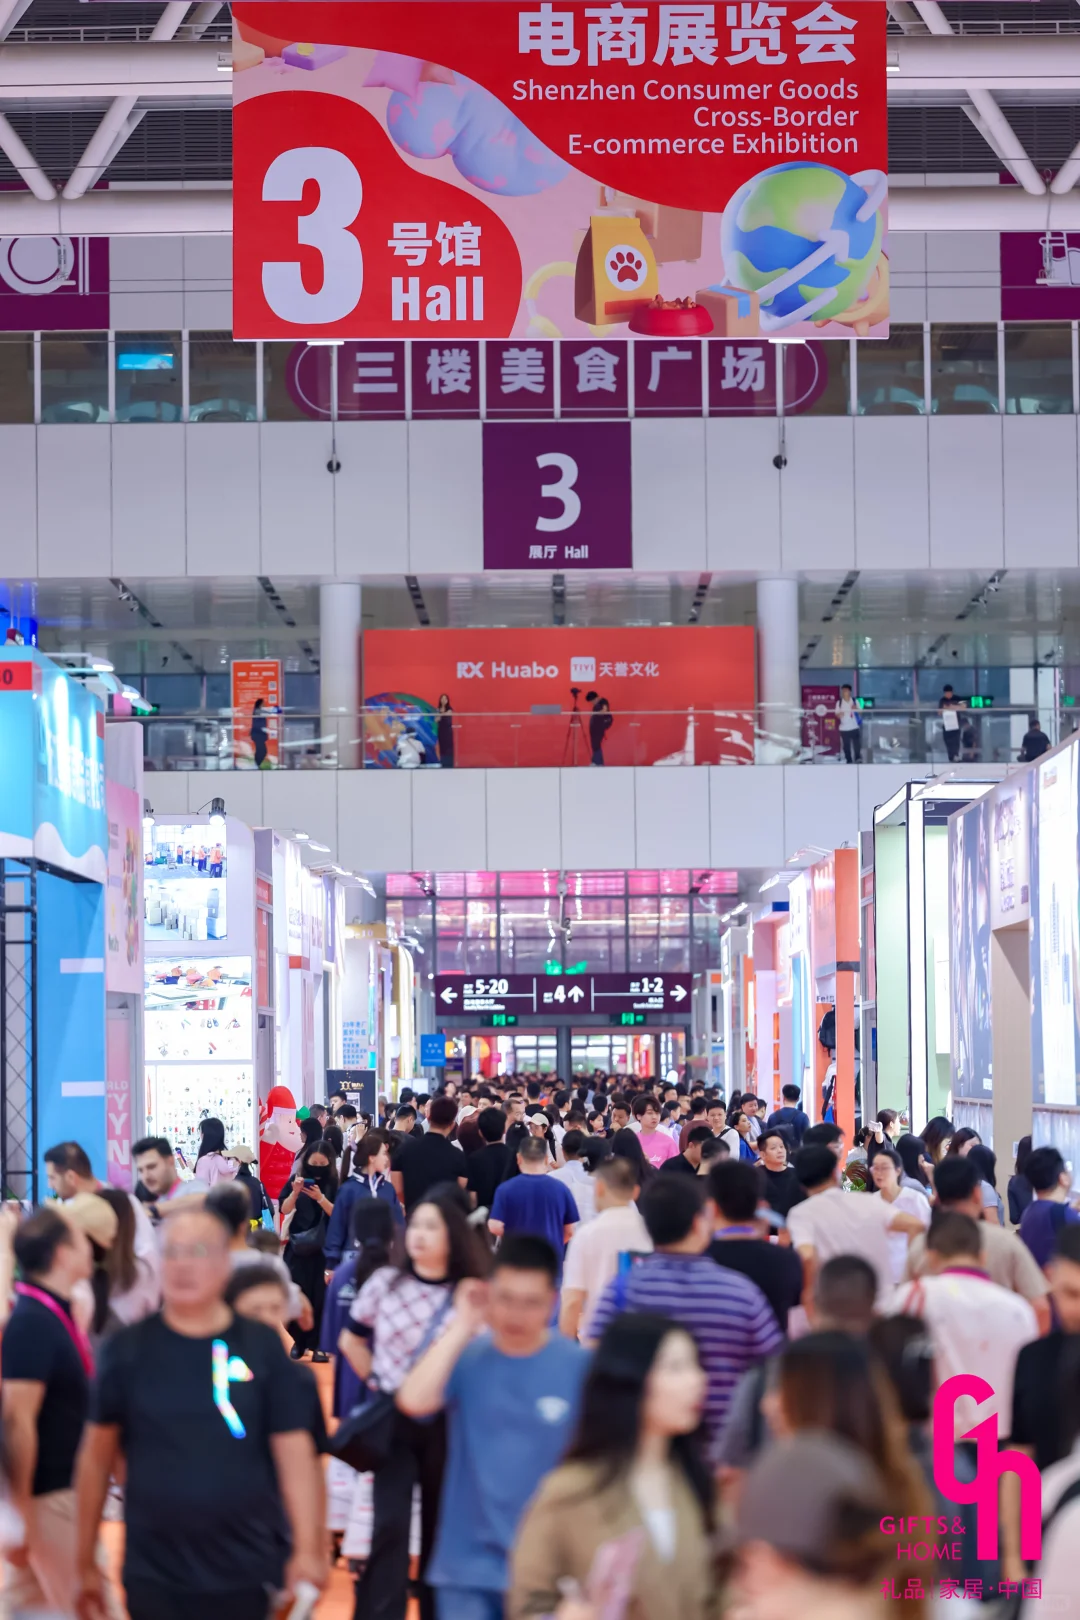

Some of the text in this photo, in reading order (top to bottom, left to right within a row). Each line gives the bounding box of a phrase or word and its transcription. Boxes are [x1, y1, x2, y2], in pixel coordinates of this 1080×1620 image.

[518, 3, 858, 67] 电商展览会
[513, 79, 859, 101] Shenzhen Consumer Goods
[694, 104, 859, 127] Cross-Border
[568, 132, 858, 154] E-commerce Exhibition
[261, 146, 364, 325] 3
[388, 221, 482, 267] 号馆
[391, 276, 484, 322] Hall
[353, 347, 766, 394] 三楼美食广场
[535, 452, 582, 533] 3
[528, 544, 589, 559] 展厅 Hall
[0, 668, 13, 685] 0
[456, 661, 559, 678] RX Huabo
[599, 661, 660, 677] 天誉文化
[475, 978, 509, 994] 5-20
[554, 984, 566, 1003] 4
[641, 977, 664, 993] 1-2
